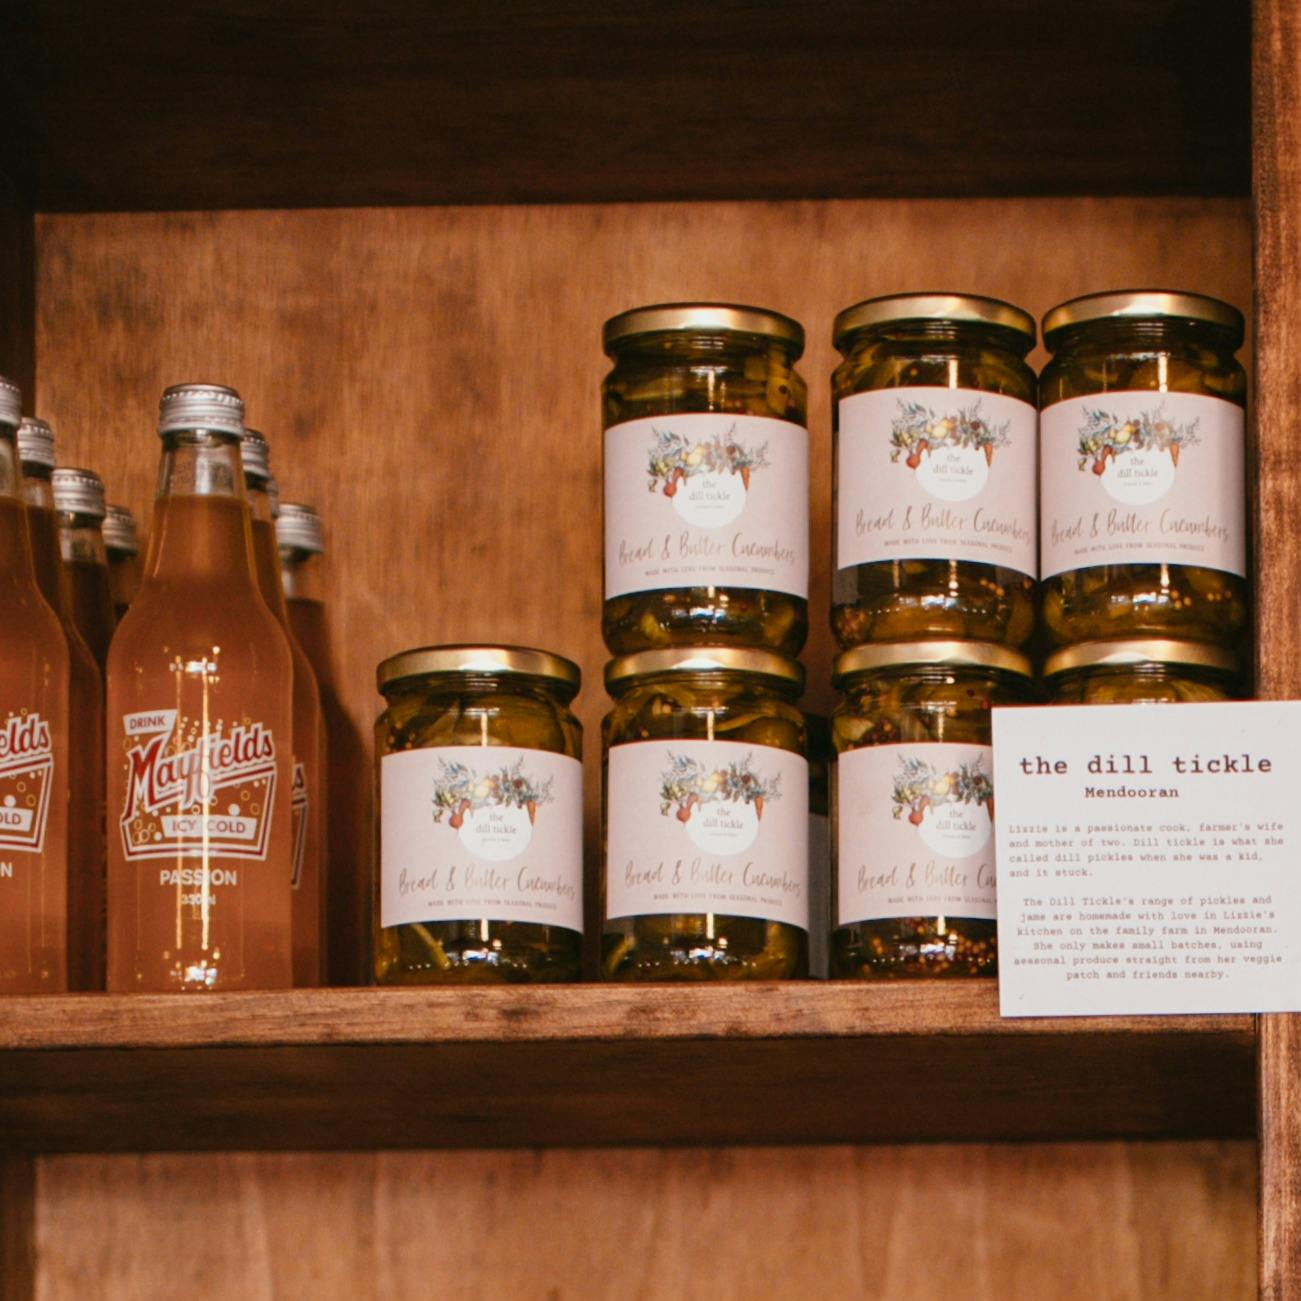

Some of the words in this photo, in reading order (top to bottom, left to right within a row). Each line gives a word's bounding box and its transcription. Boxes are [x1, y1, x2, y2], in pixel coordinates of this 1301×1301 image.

[129, 716, 166, 729] DRINK
[1019, 755, 1068, 776] the
[1087, 754, 1153, 775] dill
[1172, 753, 1272, 774] tickle
[123, 725, 275, 822] Mayfields
[1084, 785, 1180, 799] Mendooran
[172, 820, 195, 834] ICY
[208, 820, 246, 834] COLD
[1008, 824, 1049, 834] Lizzie
[1055, 824, 1068, 833] is
[1074, 825, 1081, 833] a
[1087, 823, 1153, 835] passionate
[1159, 823, 1191, 833] cook,
[1199, 822, 1251, 833] farmer's
[1256, 821, 1284, 832] wife
[160, 869, 237, 886] PASSON
